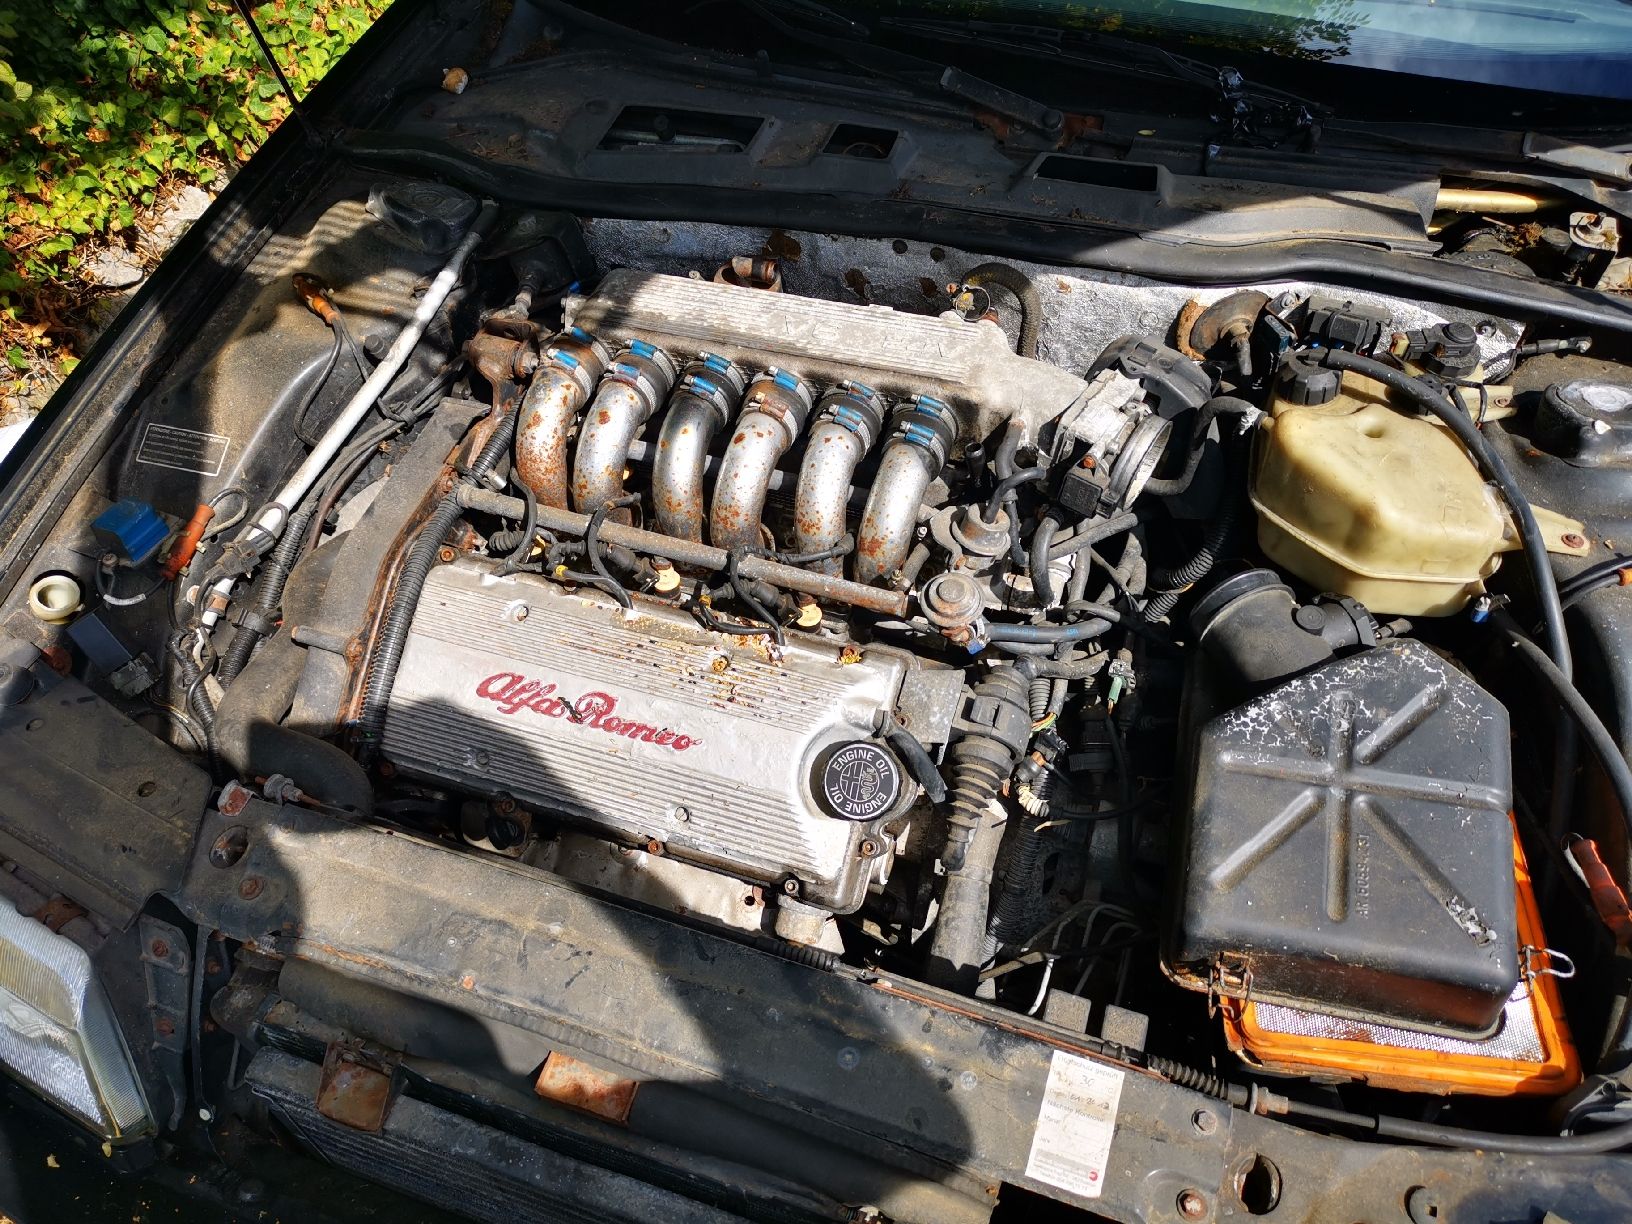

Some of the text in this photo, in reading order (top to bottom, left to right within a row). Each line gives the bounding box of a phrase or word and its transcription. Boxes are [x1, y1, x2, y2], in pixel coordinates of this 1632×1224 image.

[475, 671, 702, 751] Alfa Romeo
[832, 749, 890, 779] ENGINE OIL
[830, 782, 887, 814] ENGINE OIL
